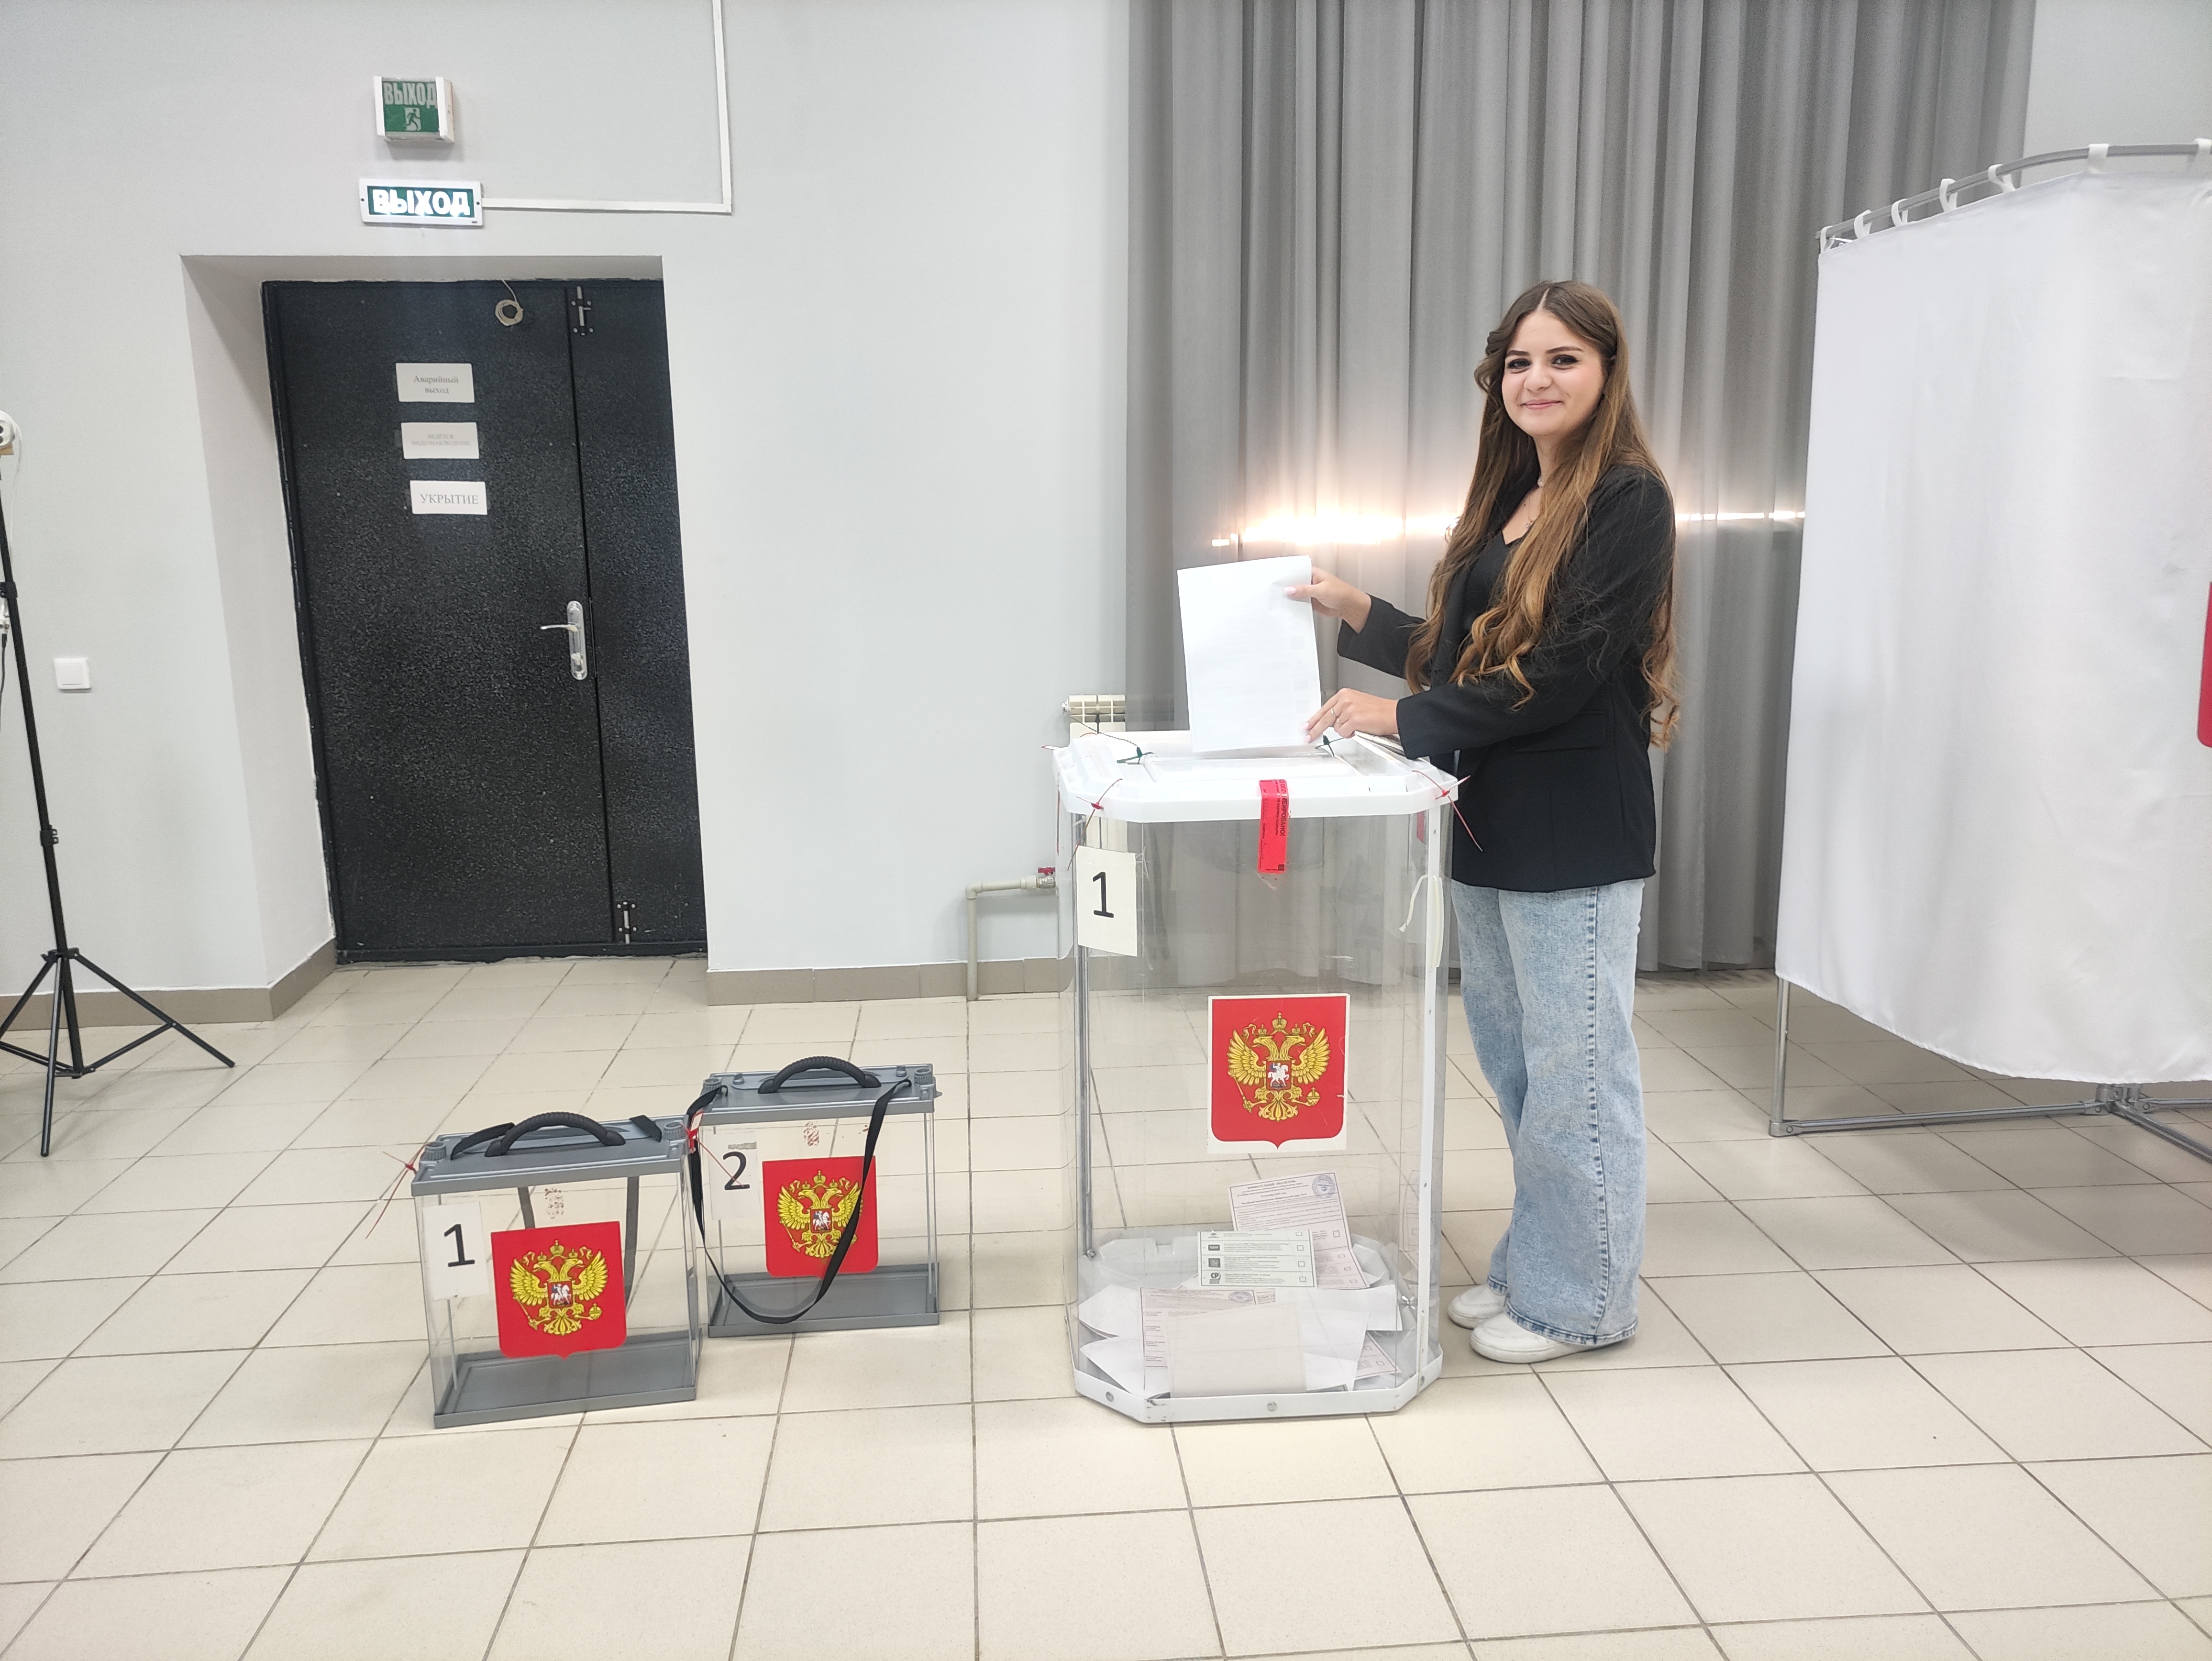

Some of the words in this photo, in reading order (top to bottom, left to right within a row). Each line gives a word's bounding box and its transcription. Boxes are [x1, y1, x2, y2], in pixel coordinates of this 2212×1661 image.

[383, 81, 438, 109] ВЫХОД
[372, 189, 471, 217] ВЫХОД
[414, 375, 459, 385] Аварийный
[420, 494, 479, 505] УКРЫТИЕ
[1093, 871, 1114, 919] 1
[722, 1151, 751, 1191] 2
[443, 1223, 476, 1268] 1
